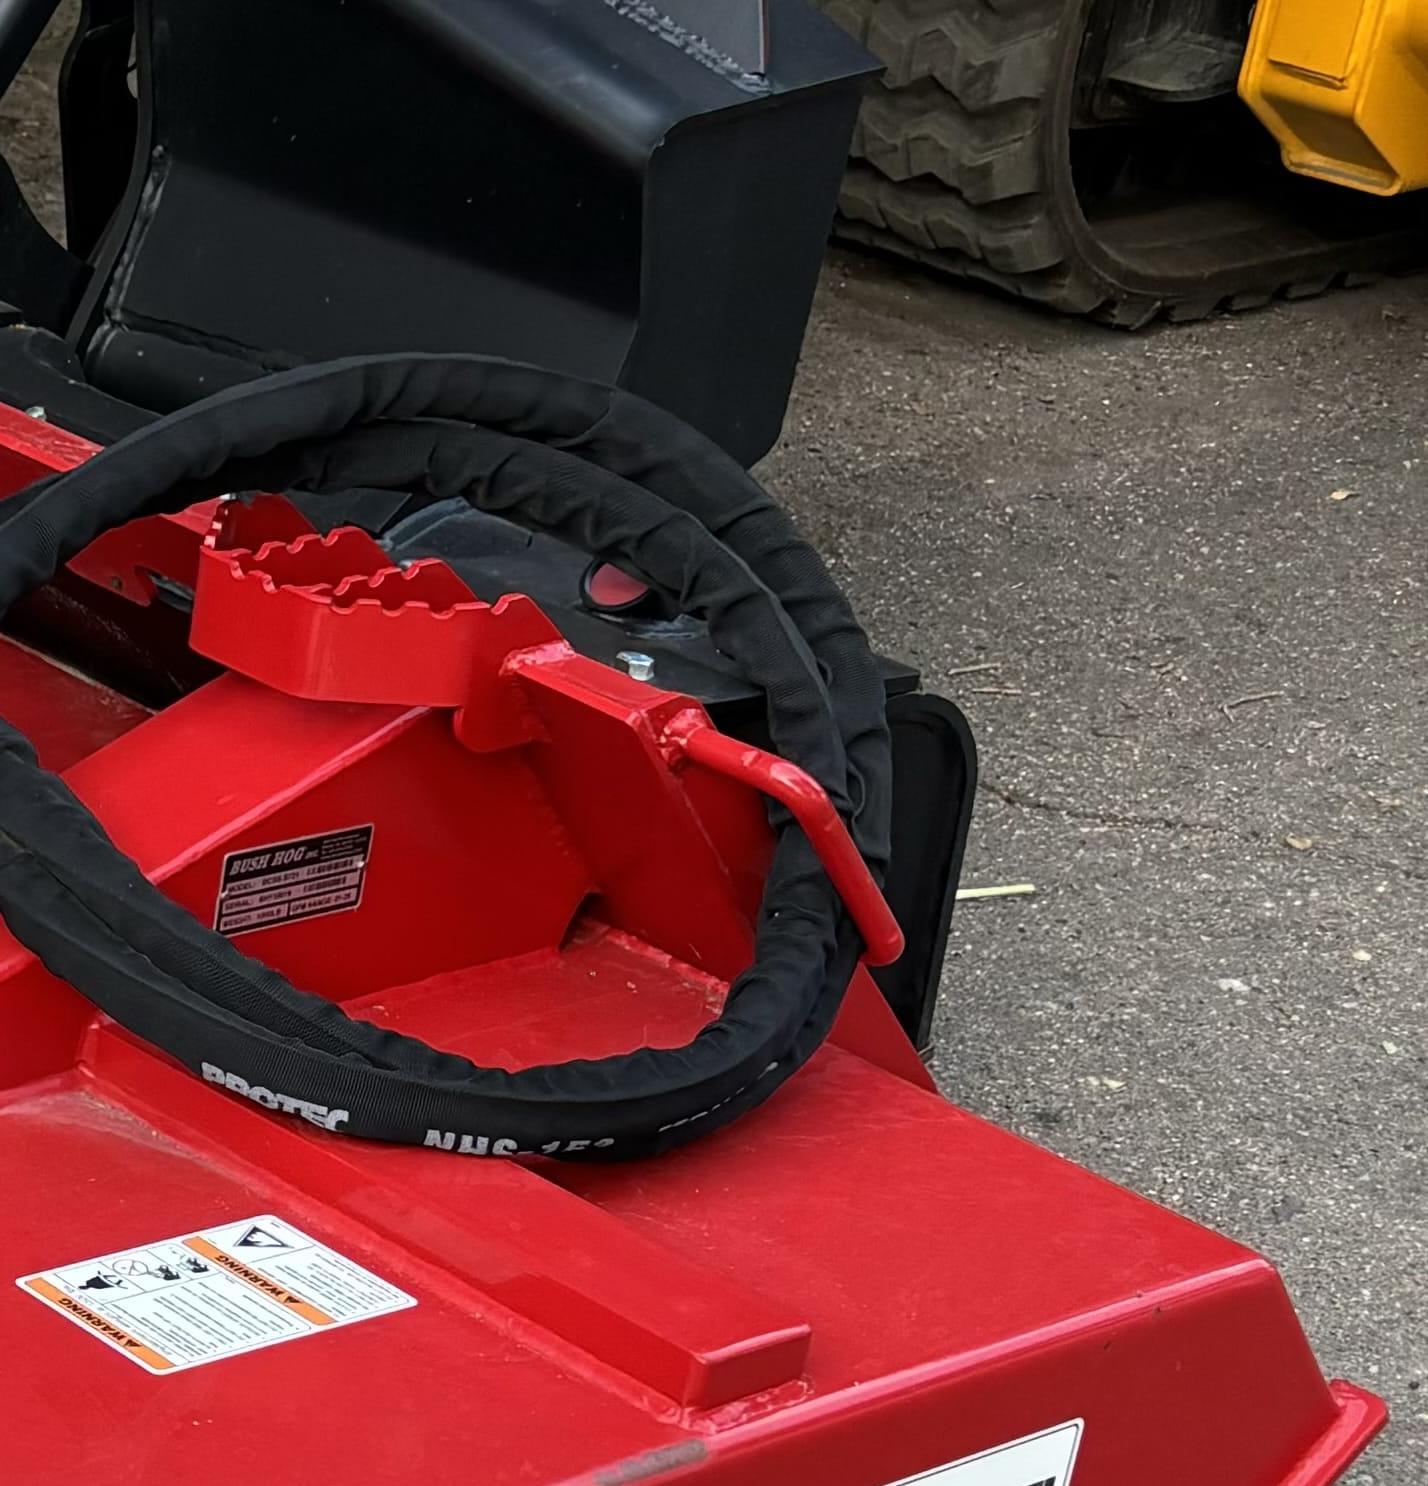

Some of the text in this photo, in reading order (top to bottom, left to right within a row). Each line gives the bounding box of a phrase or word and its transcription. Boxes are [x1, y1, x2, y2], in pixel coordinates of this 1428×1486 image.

[229, 853, 272, 876] BUSH
[271, 846, 307, 867] HOG
[201, 1061, 350, 1132] PROTEC
[212, 1254, 286, 1296] WARNING
[55, 1297, 128, 1340] WARNING
